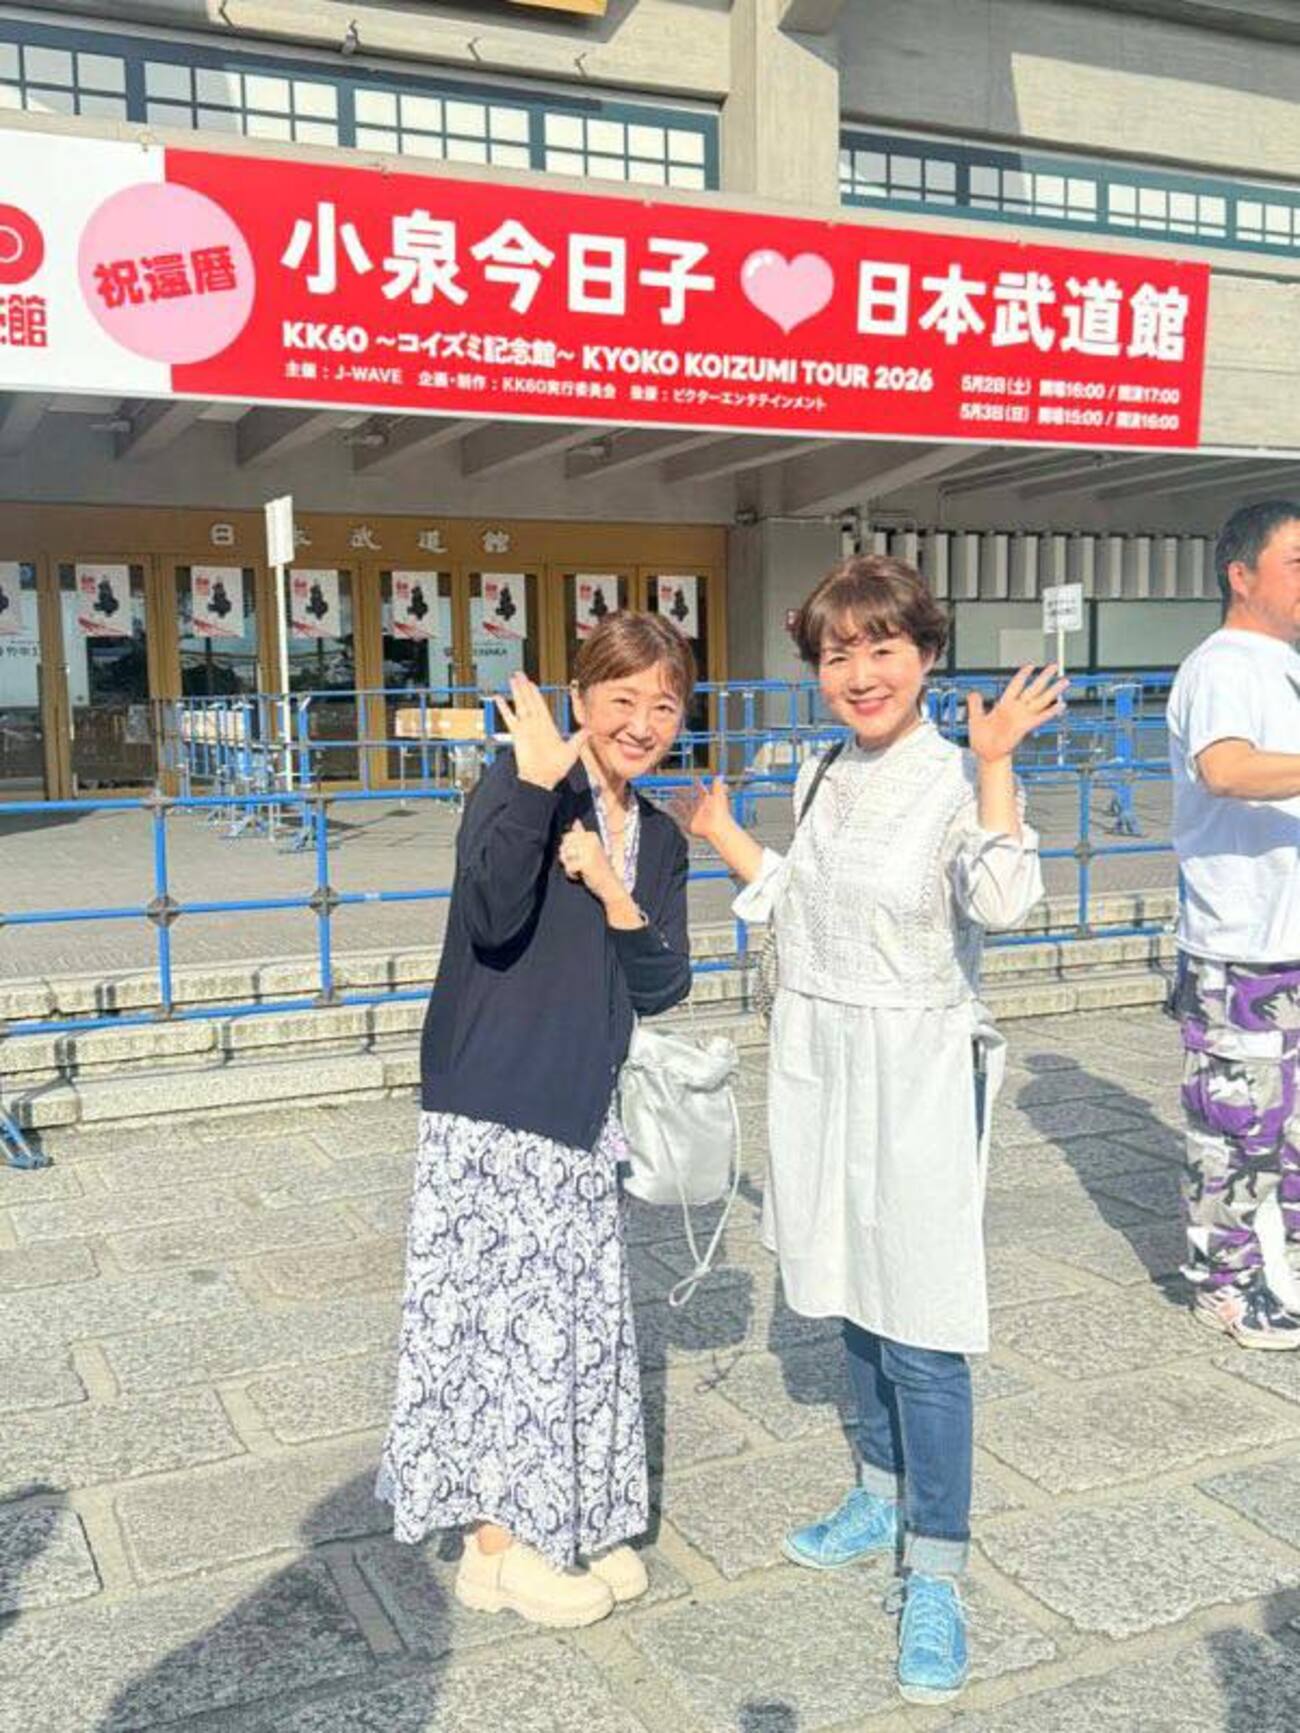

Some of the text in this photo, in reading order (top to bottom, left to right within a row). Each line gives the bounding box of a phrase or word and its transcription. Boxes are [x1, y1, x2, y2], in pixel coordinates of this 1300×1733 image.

[92, 244, 238, 309] 祝還暦
[281, 202, 1190, 363] 小泉今日子 日本武道館
[282, 321, 370, 353] KK60
[582, 345, 680, 377] KYOKO
[684, 352, 797, 384] KOIZUMI
[801, 360, 870, 389] TOUR
[873, 366, 934, 392] 2026
